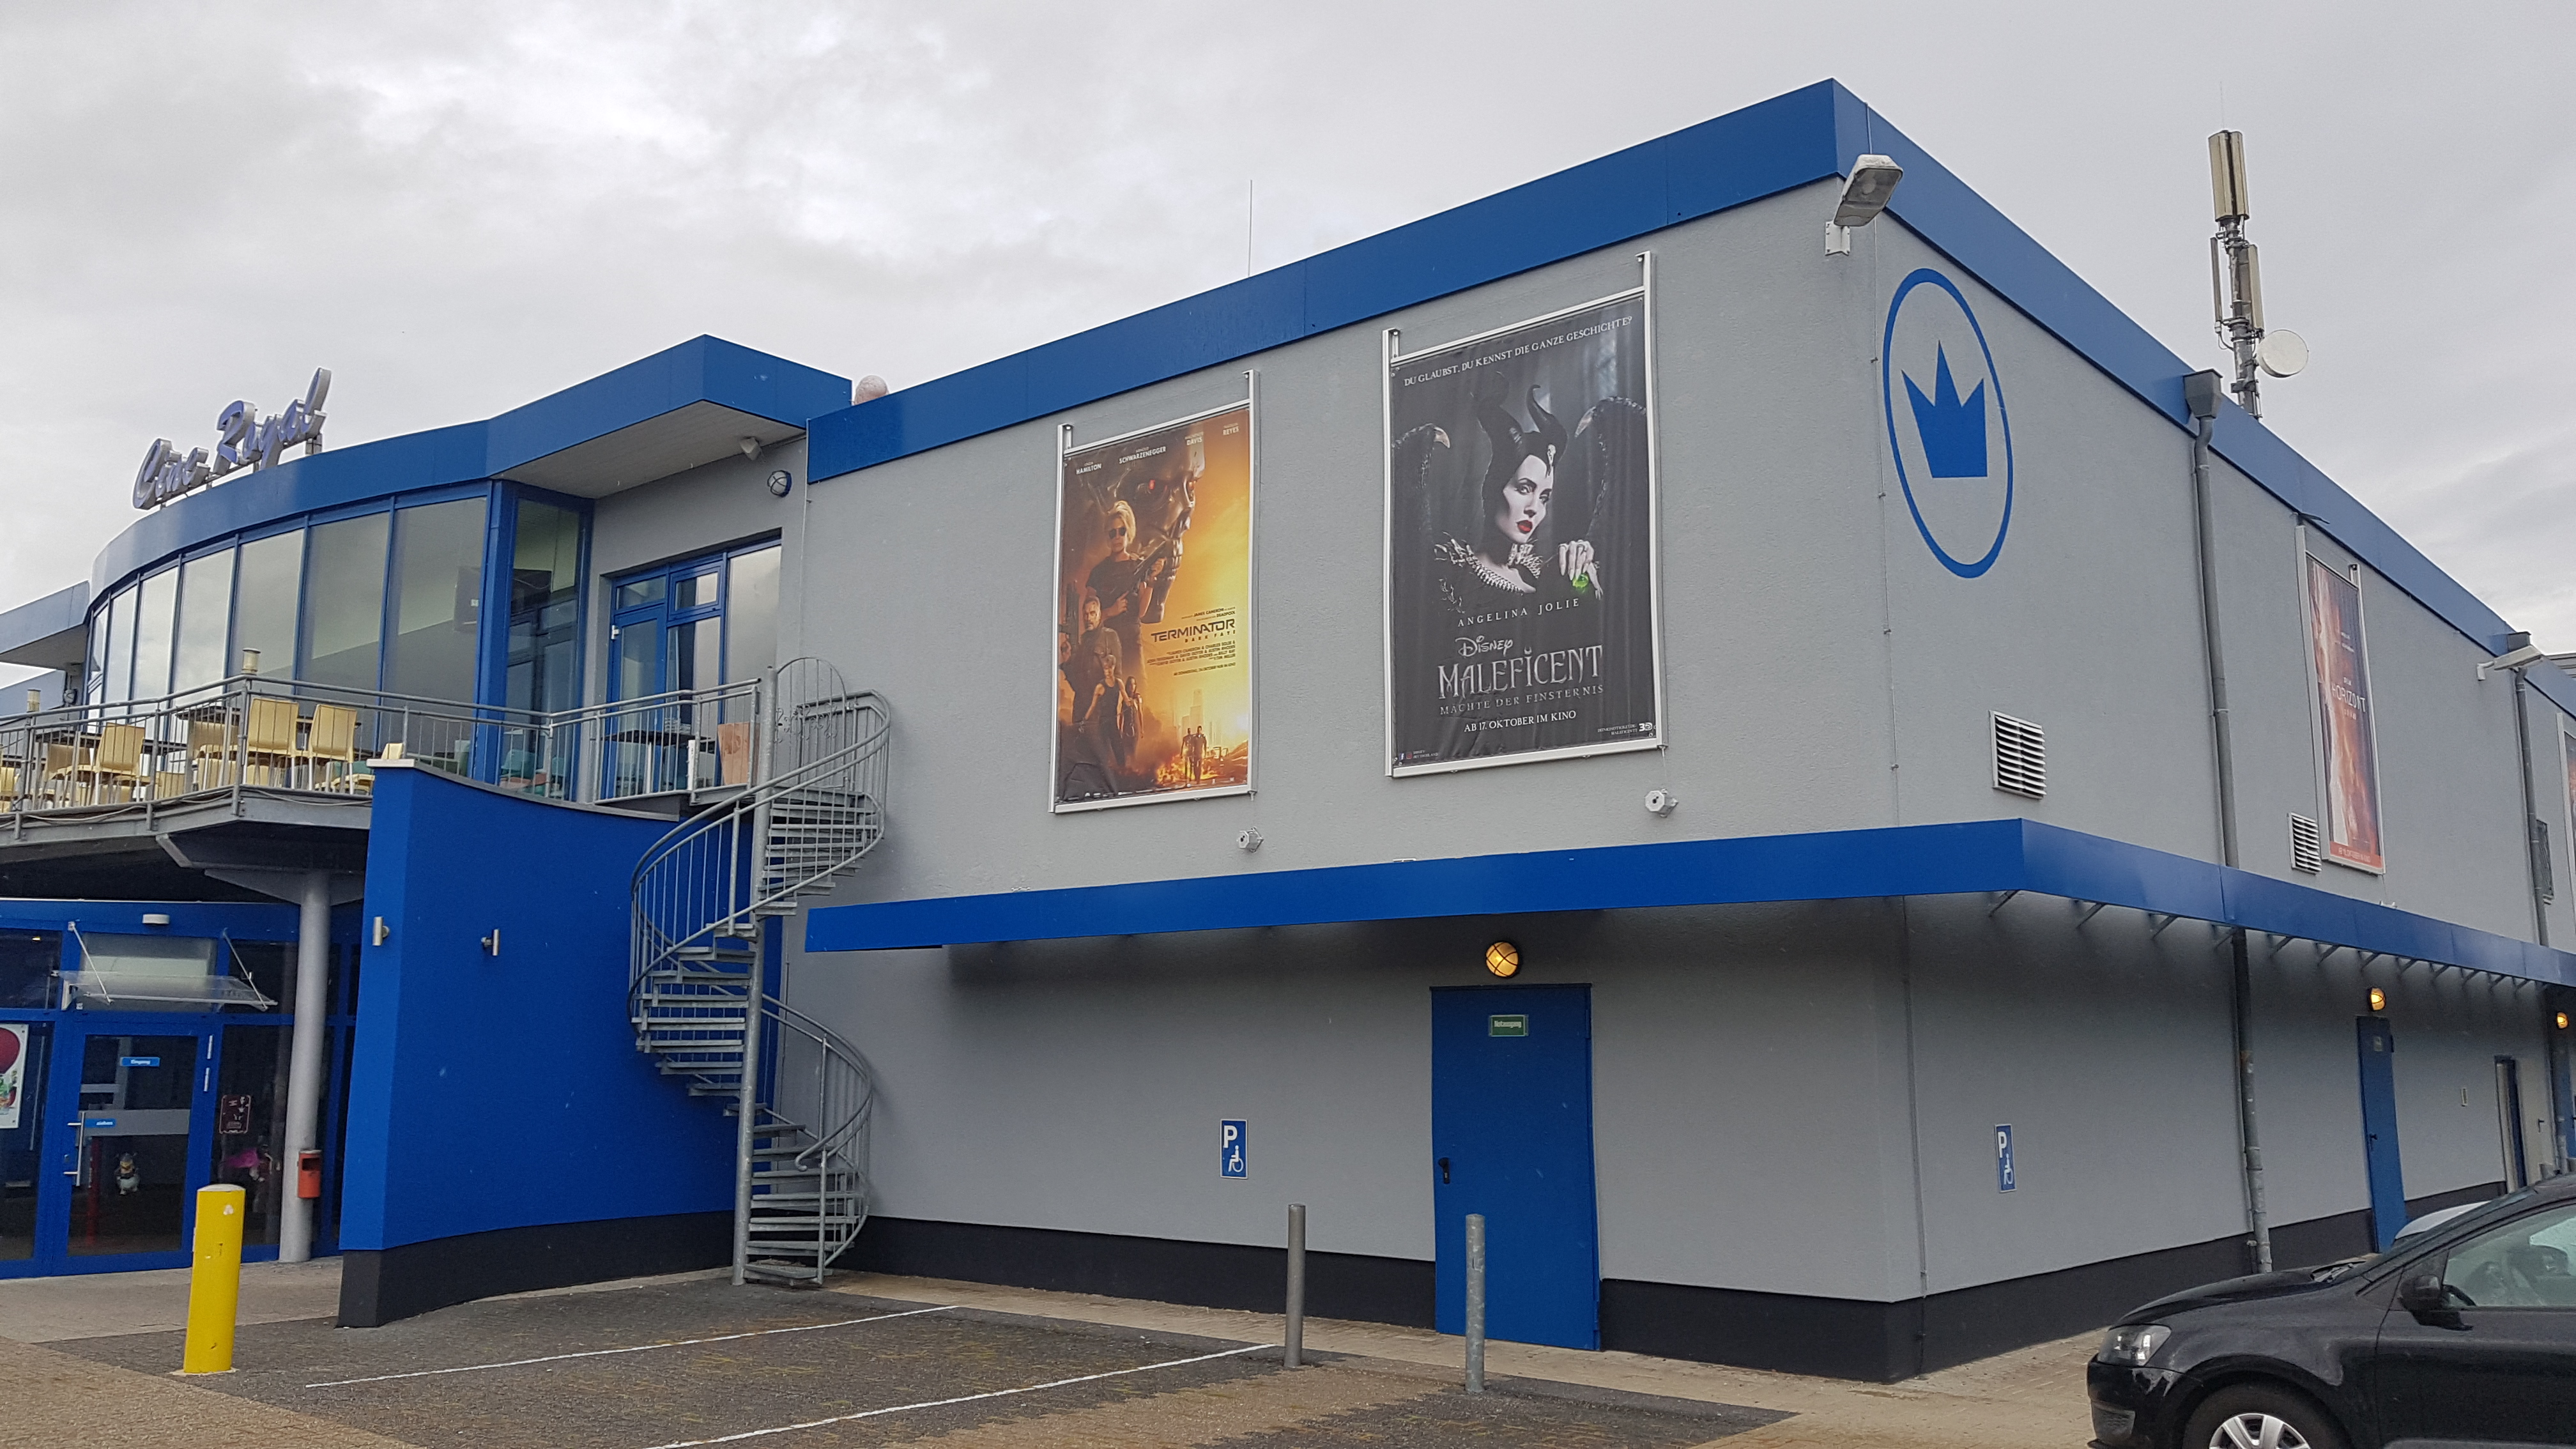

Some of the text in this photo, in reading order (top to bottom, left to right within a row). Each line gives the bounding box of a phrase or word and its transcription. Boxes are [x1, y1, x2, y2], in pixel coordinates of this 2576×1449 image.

[1404, 376, 1416, 387] DU
[1462, 361, 1473, 371] DU
[1475, 349, 1513, 367] KENNST
[1514, 344, 1530, 356] DIE
[1531, 335, 1565, 351] GANZE
[1566, 316, 1633, 342] GESCHICHTE?
[1119, 446, 1166, 464] SCHWARZENEGGER
[1076, 463, 1102, 475] HAMILTON
[1457, 598, 1579, 627] ANGELINA JOLIE
[1151, 618, 1235, 643] TERMINATOR
[1184, 629, 1236, 643] DARK FATE
[1438, 645, 1604, 700] MALEFICENT
[1496, 696, 1520, 707] DER
[1526, 684, 1604, 703] FINSTERNIS
[1464, 710, 1577, 732] AB 17. OKTOBER IM KINO
[1223, 1125, 1238, 1149] P
[1997, 1131, 2007, 1158] P
